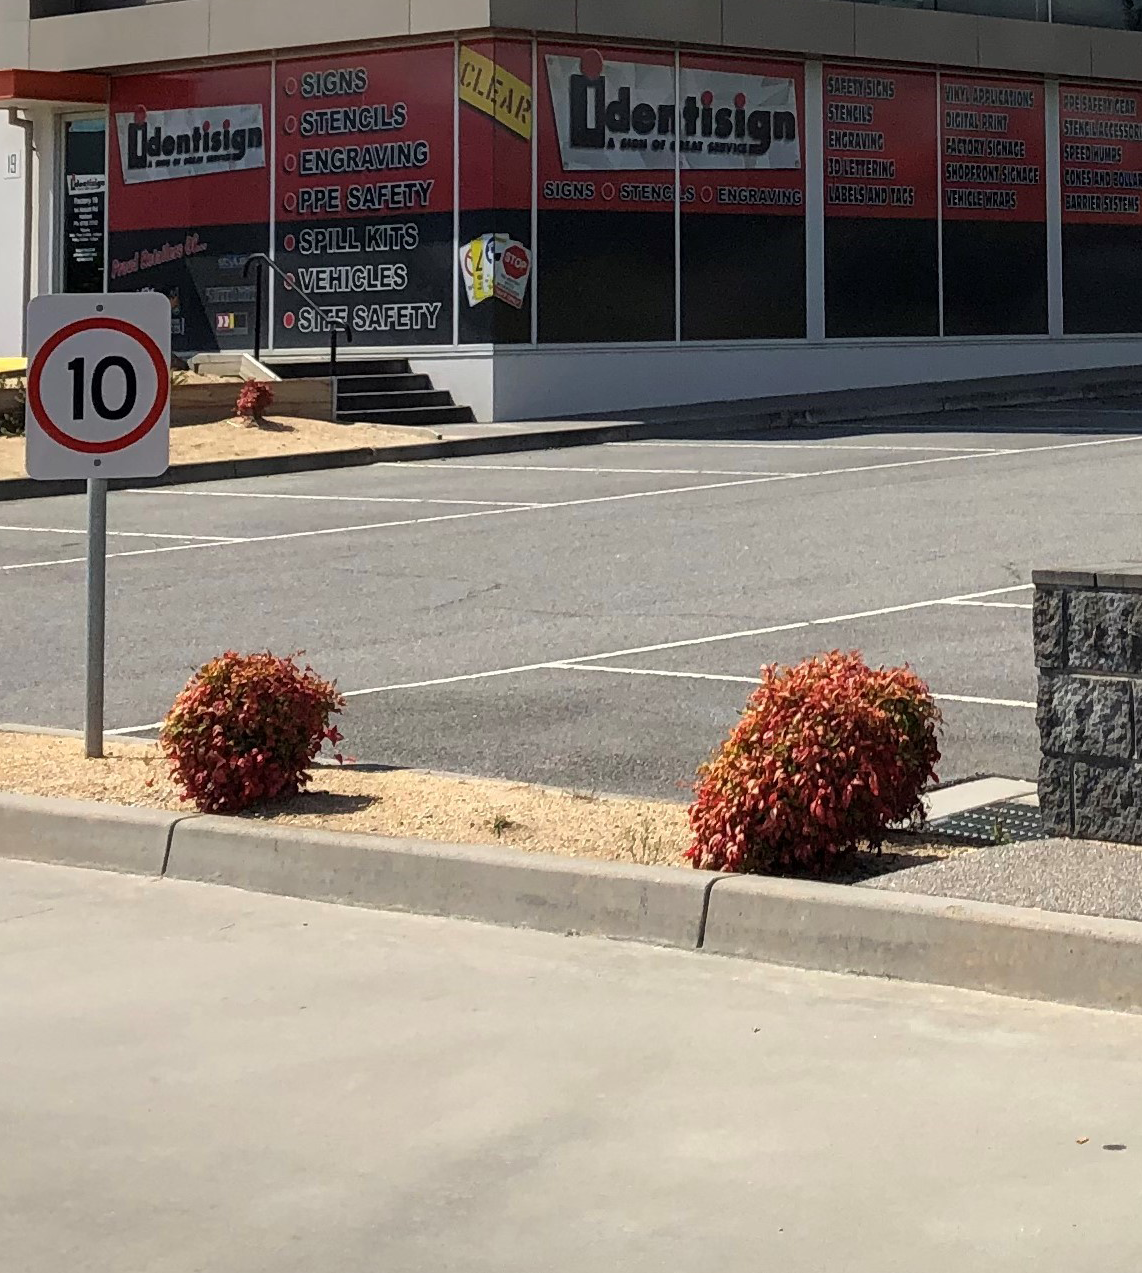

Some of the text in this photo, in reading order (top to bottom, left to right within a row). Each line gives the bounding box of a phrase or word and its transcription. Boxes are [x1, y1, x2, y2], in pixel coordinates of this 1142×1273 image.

[301, 67, 368, 98] SIGNS
[460, 62, 531, 124] CLEAR
[827, 76, 895, 99] SAFETY SIGNS
[945, 84, 1034, 108] VINYL APPLICATIONS
[1114, 97, 1136, 116] GEAR
[301, 102, 407, 136] STENCILS
[827, 102, 873, 124] STENCILS
[945, 111, 1008, 132] DIGITAL PRINT
[1063, 119, 1097, 138] STENCIL
[827, 130, 884, 151] ENGRAVING
[945, 137, 1025, 159] FACTORY SIGNAGE
[8, 154, 16, 173] 19
[300, 140, 430, 175] ENGRAVING
[1064, 143, 1122, 165] SPEED HUMPS
[827, 157, 895, 178] 3D LETTERING
[945, 162, 1039, 185] SHOPFRONT SIGNAGE
[1064, 168, 1092, 187] CONES
[1093, 170, 1111, 188] AND
[299, 180, 434, 213] PPE SAFETY
[544, 181, 595, 199] SIGNS
[717, 186, 802, 205] ENGRAVING
[828, 184, 914, 205] LABELS AND TAGS
[946, 188, 1017, 209] VEHICLE WRAPS
[1065, 193, 1140, 214] BARRIER SYSTEMS
[299, 223, 418, 254] SPILL KITS
[505, 252, 527, 268] STOP
[298, 264, 408, 293] VEHICLES
[298, 303, 442, 332] SITE SAFETY
[68, 355, 137, 421] 10
